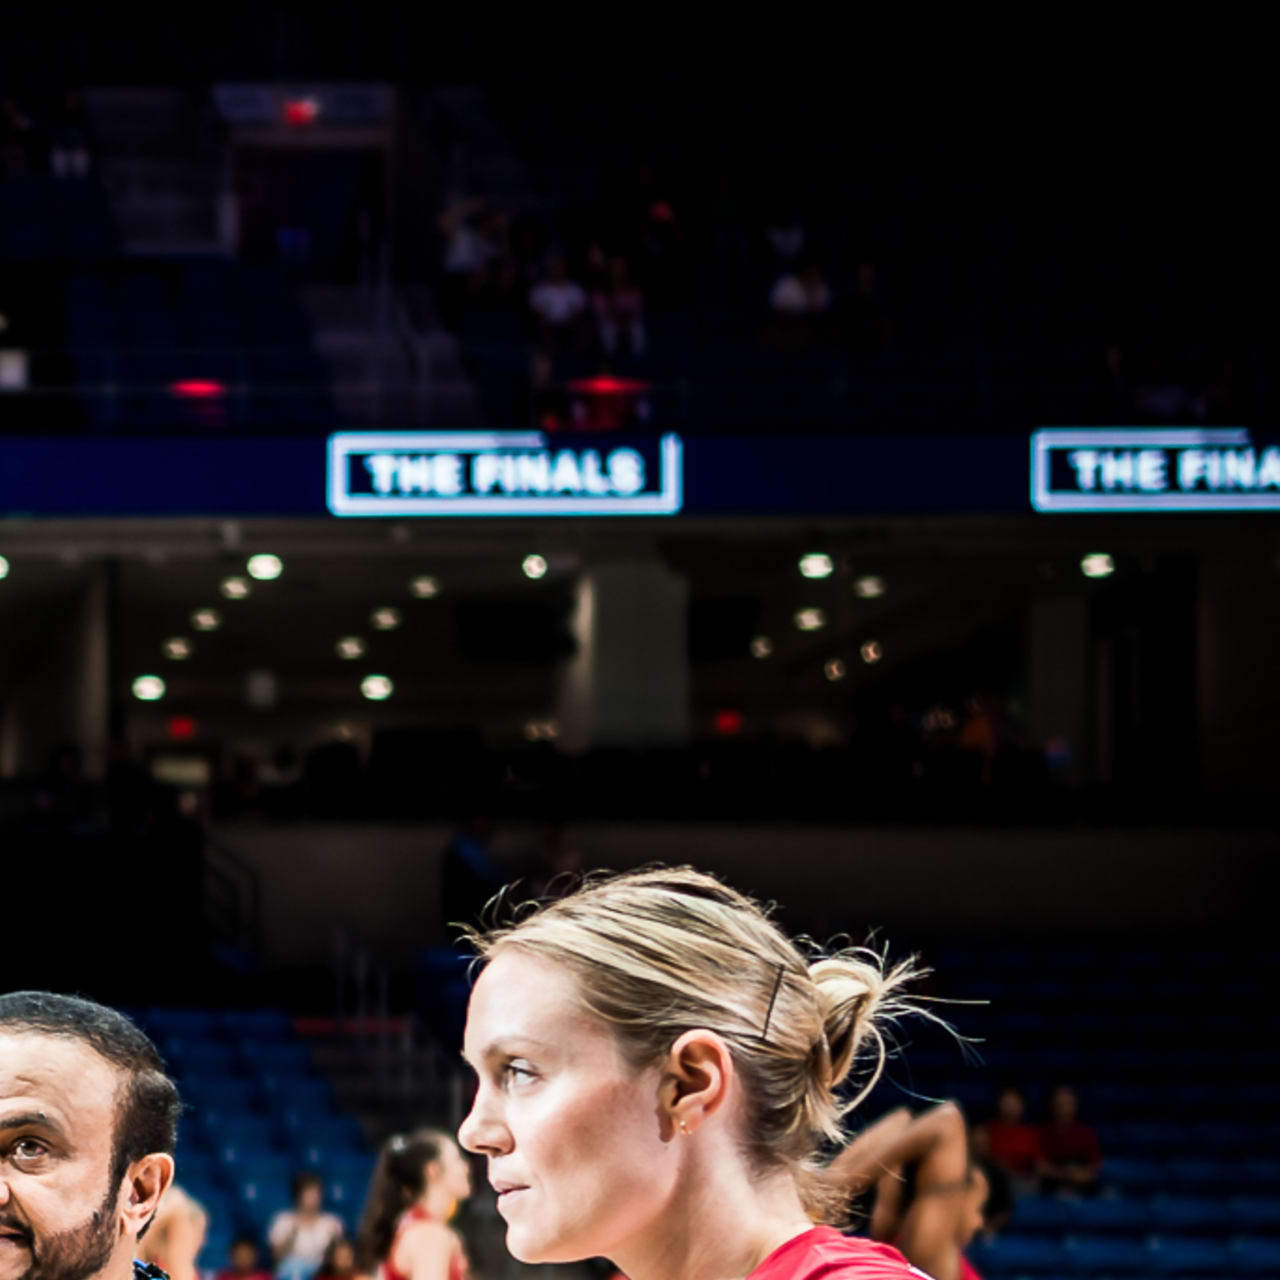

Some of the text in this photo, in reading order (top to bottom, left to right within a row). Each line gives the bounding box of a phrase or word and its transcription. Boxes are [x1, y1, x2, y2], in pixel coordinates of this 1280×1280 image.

[364, 447, 644, 495] THE FINALS
[1068, 445, 1280, 491] THE FINA
